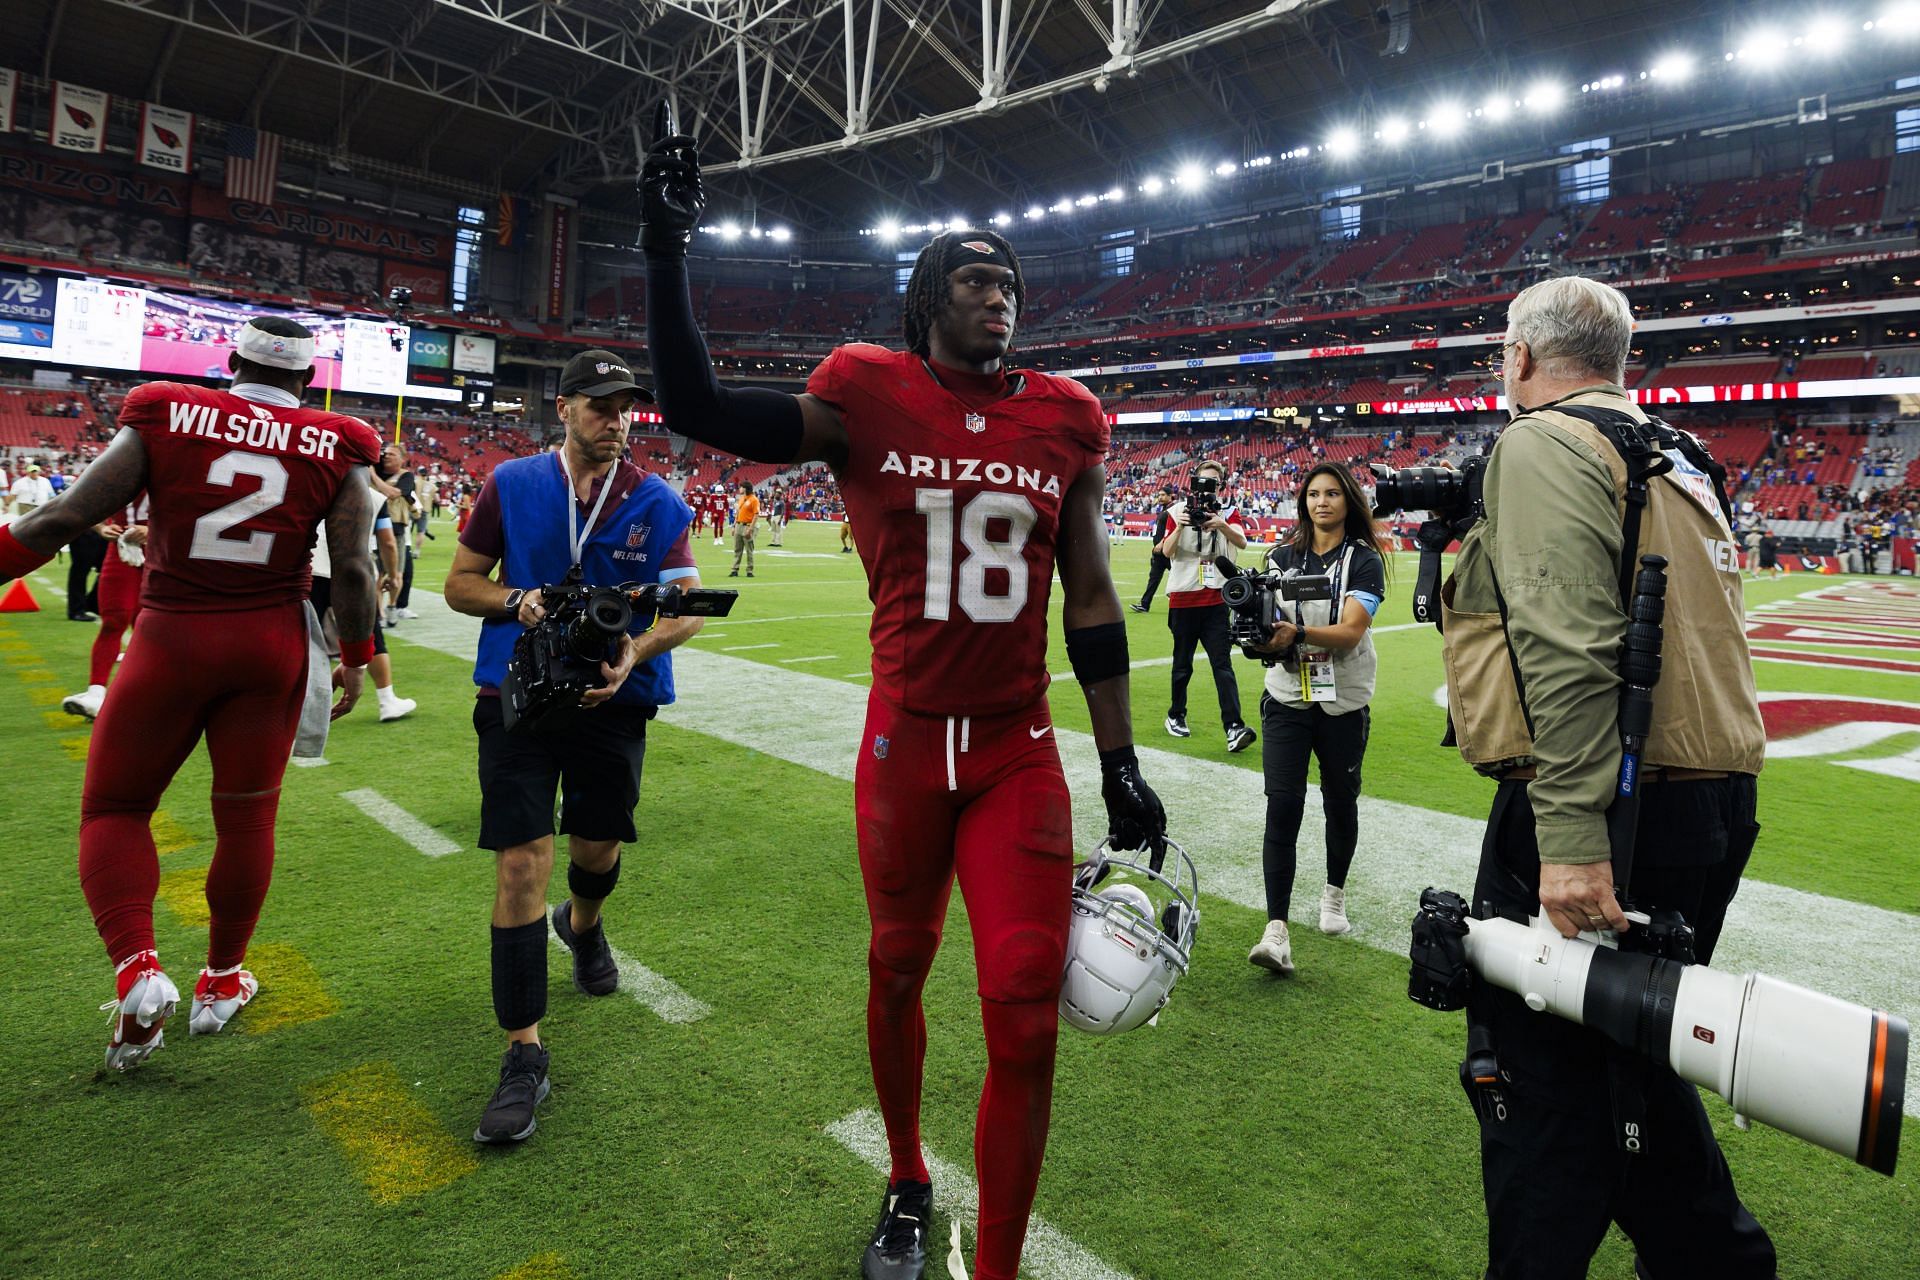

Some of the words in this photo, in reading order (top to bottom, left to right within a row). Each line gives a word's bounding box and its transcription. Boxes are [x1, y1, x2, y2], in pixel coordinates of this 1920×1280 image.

[229, 201, 438, 257] CARDINALS
[413, 341, 448, 355] COX
[1187, 359, 1204, 368] COX
[1273, 407, 1298, 418] 0:00
[1382, 402, 1398, 412] 41
[1403, 401, 1450, 410] CARDINALS
[169, 401, 292, 451] WILSON
[297, 425, 339, 461] SR
[879, 451, 1060, 498] ARIZONA
[188, 450, 290, 566] 2
[612, 549, 626, 560] NFL
[626, 551, 648, 562] FILMS
[915, 487, 1038, 623] 18
[1625, 1122, 1640, 1152] SO
